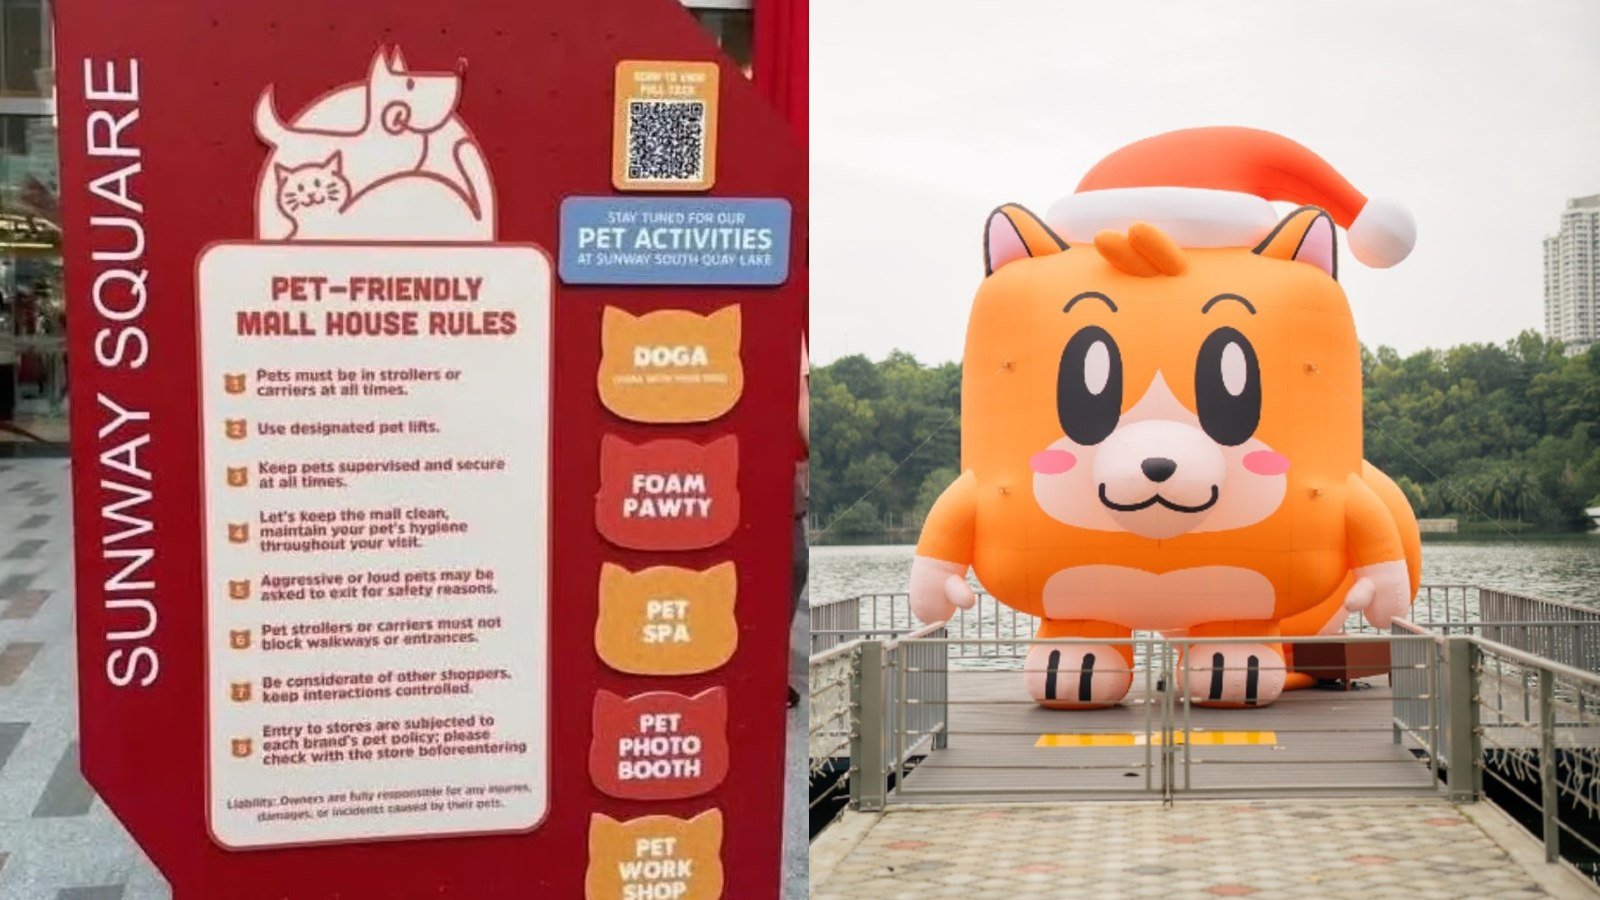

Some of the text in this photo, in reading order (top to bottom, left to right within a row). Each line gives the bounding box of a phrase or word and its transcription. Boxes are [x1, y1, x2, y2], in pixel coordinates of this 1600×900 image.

[608, 212, 746, 224] STAY TUNED FOR OUR
[578, 227, 773, 250] PET ACTIVITIES
[578, 252, 773, 266] AT SUNWAY SOUTH QUAY LAKE
[271, 276, 484, 301] PET-FRIENDLY
[236, 311, 518, 336] MALL HOUSE RULES
[633, 345, 709, 368] DOGA
[84, 58, 159, 687] SUNWAY SQUARE
[256, 368, 462, 382] Pets must be in strollers or
[257, 383, 408, 397] carriers at all times.
[257, 420, 440, 437] Use designated pet lifts.
[258, 458, 506, 477] Keep pets supervised and secure
[259, 475, 347, 489] at all times.
[632, 474, 706, 494] FOAM
[259, 507, 450, 524] Let's keep the mall clean,
[623, 498, 713, 519] PAWTY
[259, 521, 468, 539] maintain your pet's hygiene
[260, 536, 422, 553] throughout your visit.
[260, 568, 494, 588] Aggressive or loud pets may be
[260, 582, 498, 601] asked to exit for safety reasons.
[646, 600, 690, 621] PET
[261, 616, 502, 637] Pet strollers or carriers must not
[643, 624, 690, 644] SPA
[261, 631, 479, 651] block walkways or entrances.
[262, 676, 282, 689] Be
[286, 672, 373, 687] considerate
[377, 671, 394, 684] of
[397, 670, 436, 684] other
[262, 683, 473, 704] keep interactions controlled.
[262, 715, 495, 739] Entry to stores are subjected to
[639, 713, 682, 733] PET
[262, 738, 299, 752] each
[303, 735, 358, 749] brand's
[362, 734, 387, 747] pet
[443, 729, 491, 743] please
[618, 736, 701, 757] PHOTO
[262, 752, 307, 766] check
[311, 750, 345, 763] with
[348, 748, 373, 761] the
[377, 747, 415, 760] store
[617, 759, 701, 780] BOOTH
[280, 795, 324, 806] Owners
[327, 793, 347, 803] are
[350, 790, 375, 802] fully
[377, 786, 443, 800] responsible
[445, 785, 462, 796] for
[465, 785, 486, 796] any
[317, 809, 329, 818] or
[332, 805, 384, 817] incidents
[388, 802, 427, 813] caused
[430, 801, 444, 812] by
[447, 799, 473, 810] their
[635, 837, 677, 857] PET
[619, 859, 693, 880] WORK
[622, 881, 687, 900] SHOP
